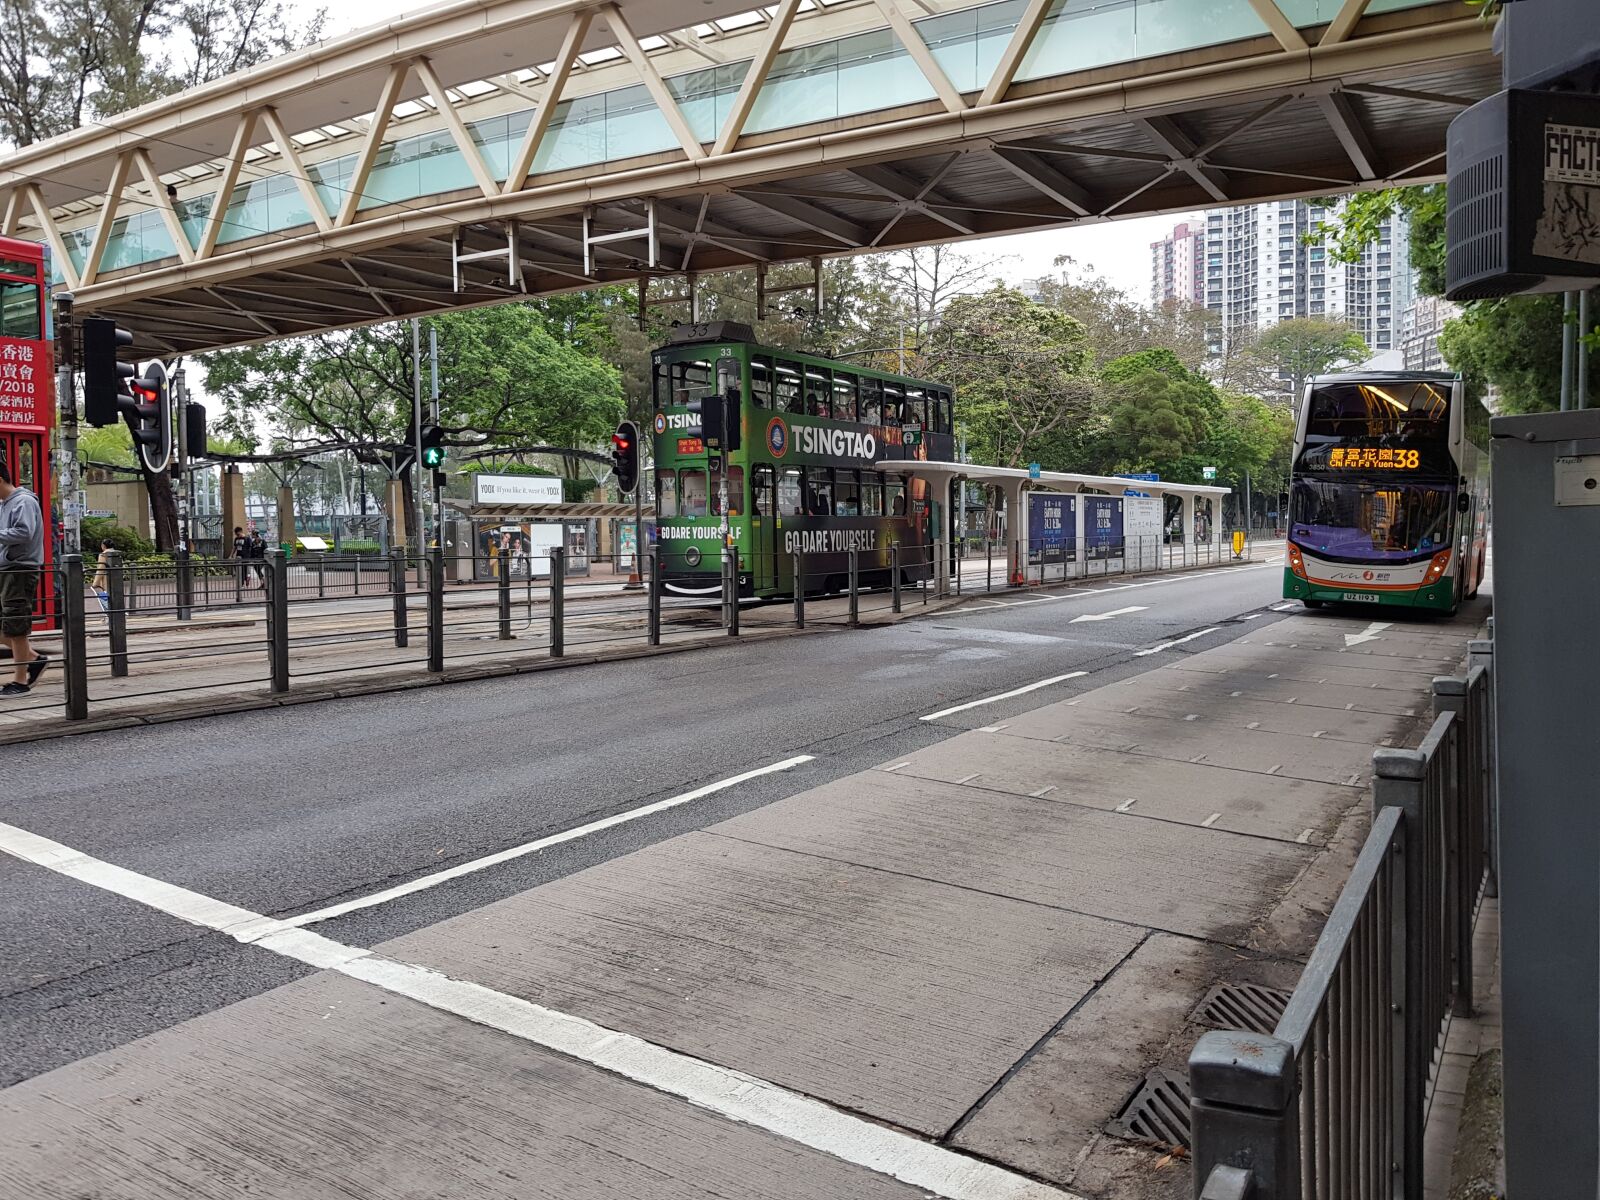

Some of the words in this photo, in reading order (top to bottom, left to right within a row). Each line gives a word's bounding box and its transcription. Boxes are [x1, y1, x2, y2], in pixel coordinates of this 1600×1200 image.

[688, 324, 708, 338] 33
[0, 345, 33, 361] 香港
[721, 348, 731, 356] 33
[0, 363, 34, 380] 賣會
[791, 425, 876, 459] TSINGTAO
[1373, 460, 1393, 468] Yuen
[1394, 449, 1419, 469] 38
[661, 527, 670, 539] GO
[671, 527, 690, 539] DARE
[692, 527, 741, 539] YOURSLF
[785, 531, 800, 553] GO
[802, 530, 828, 553] DARE
[830, 530, 875, 552] YOURSELF
